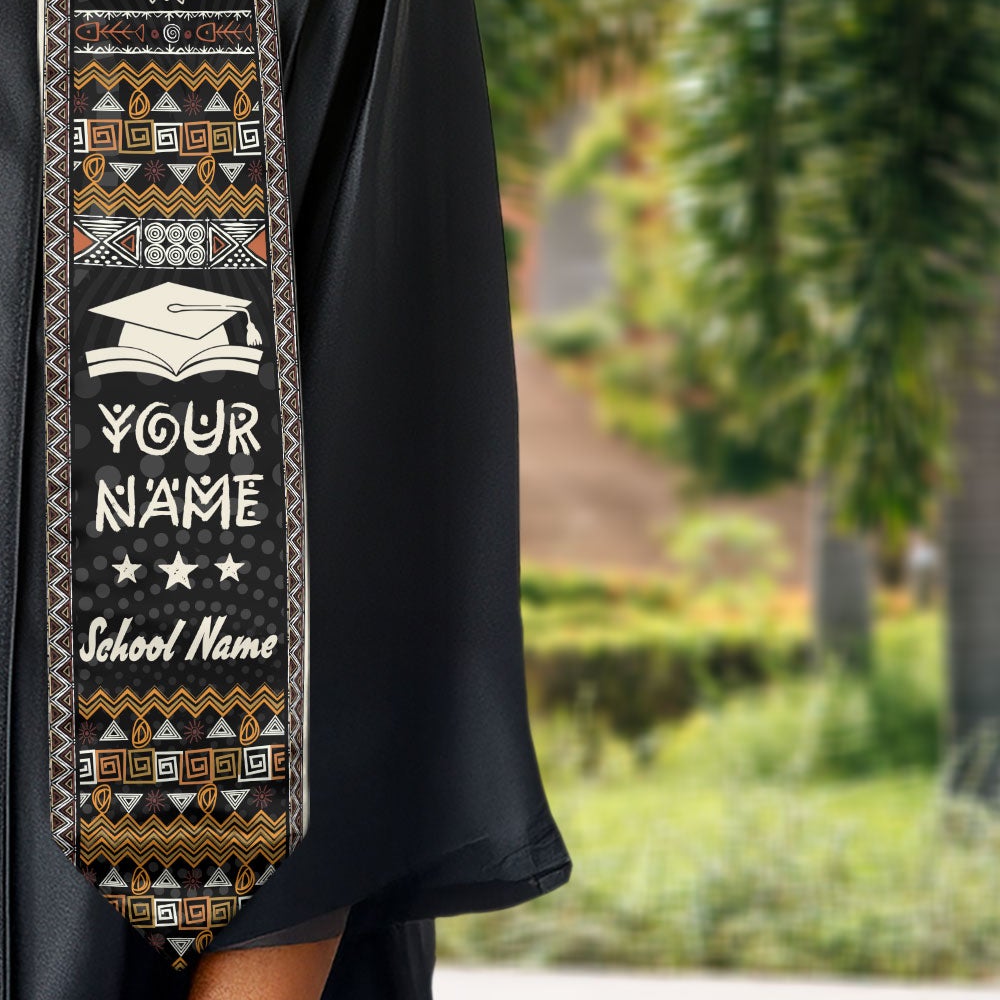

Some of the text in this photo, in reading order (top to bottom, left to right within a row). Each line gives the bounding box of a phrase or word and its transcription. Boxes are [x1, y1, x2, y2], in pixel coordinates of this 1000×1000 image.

[97, 398, 262, 456] YOUR
[95, 473, 264, 533] NAME
[79, 614, 278, 663] School Name
